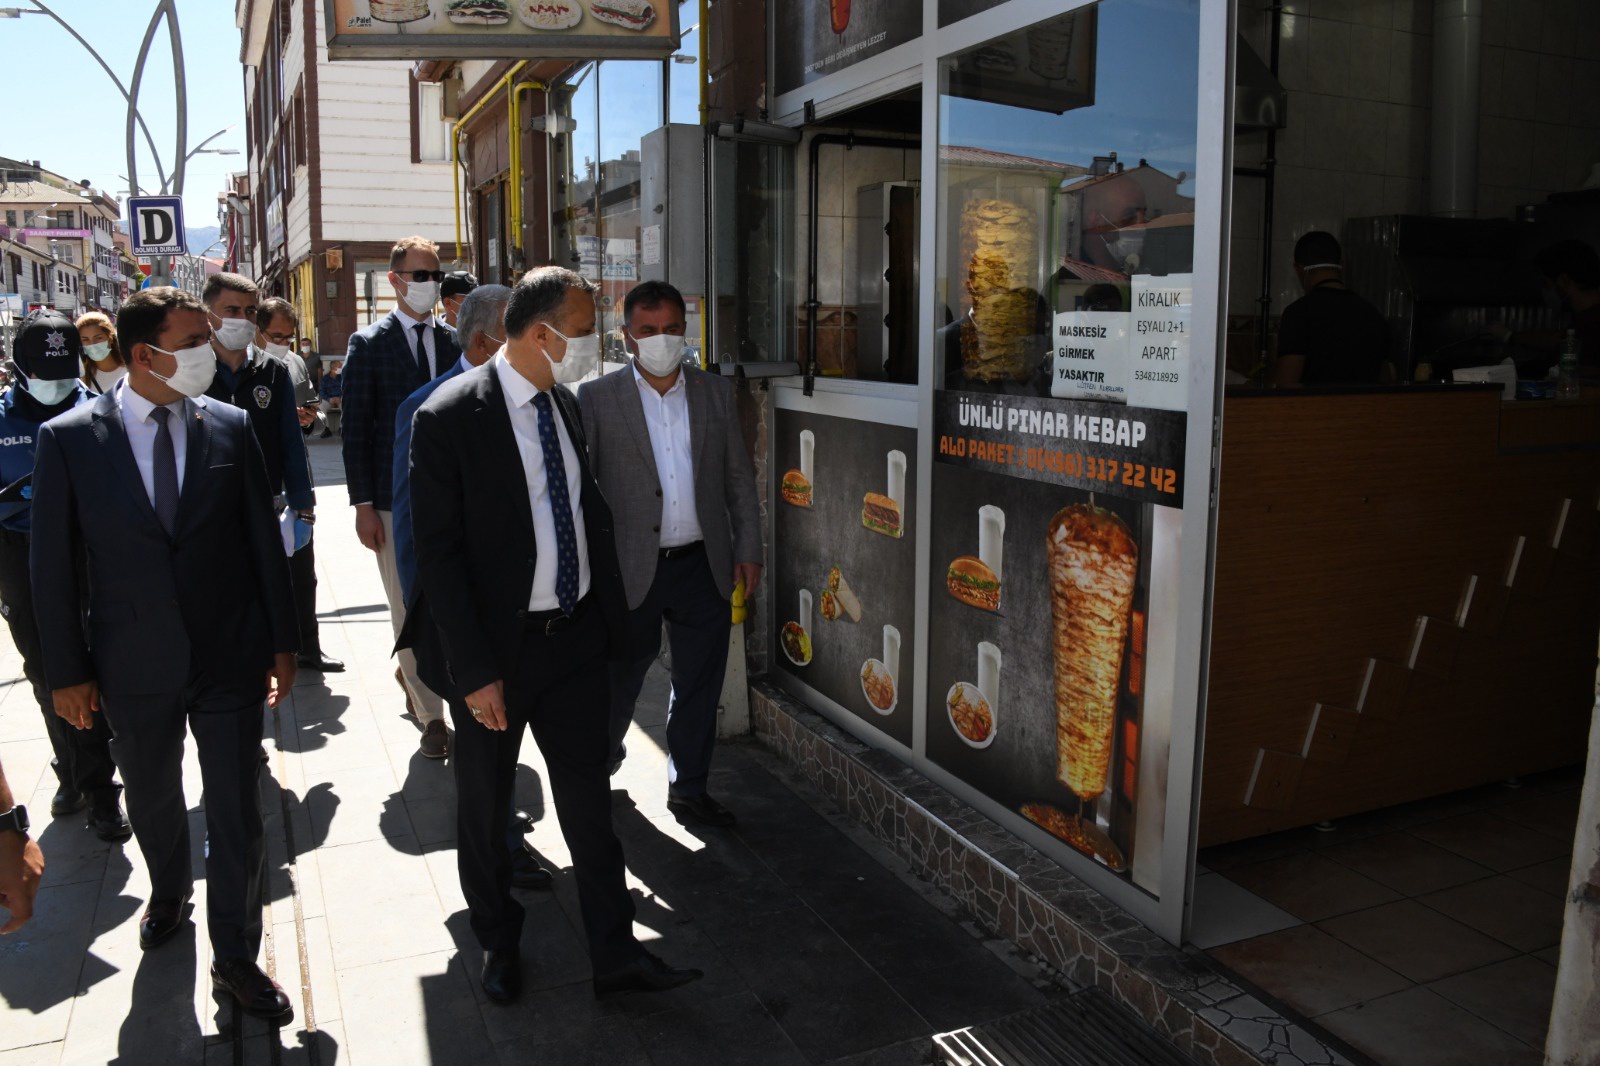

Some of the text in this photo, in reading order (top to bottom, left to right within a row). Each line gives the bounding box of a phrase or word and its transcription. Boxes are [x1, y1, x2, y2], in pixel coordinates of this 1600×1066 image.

[867, 31, 887, 46] LEZZET
[140, 208, 173, 245] D
[1138, 290, 1181, 308] KİRALIK
[1059, 325, 1107, 338] MASKESİZ
[1137, 320, 1184, 335] EŞYALI 2+1
[1059, 345, 1095, 360] GİRMEK
[1141, 346, 1178, 361] APART
[1059, 368, 1105, 383] YASAKTIR
[1134, 370, 1179, 383] 5348218929
[959, 396, 1147, 448] ÜNLÜ PINAR KEBAP
[940, 435, 966, 457] ALO
[969, 439, 1015, 465] PAKET
[1026, 447, 1083, 479] 0(456)
[1086, 456, 1118, 482] 317
[1121, 462, 1146, 488] 22
[1150, 466, 1176, 494] 42
